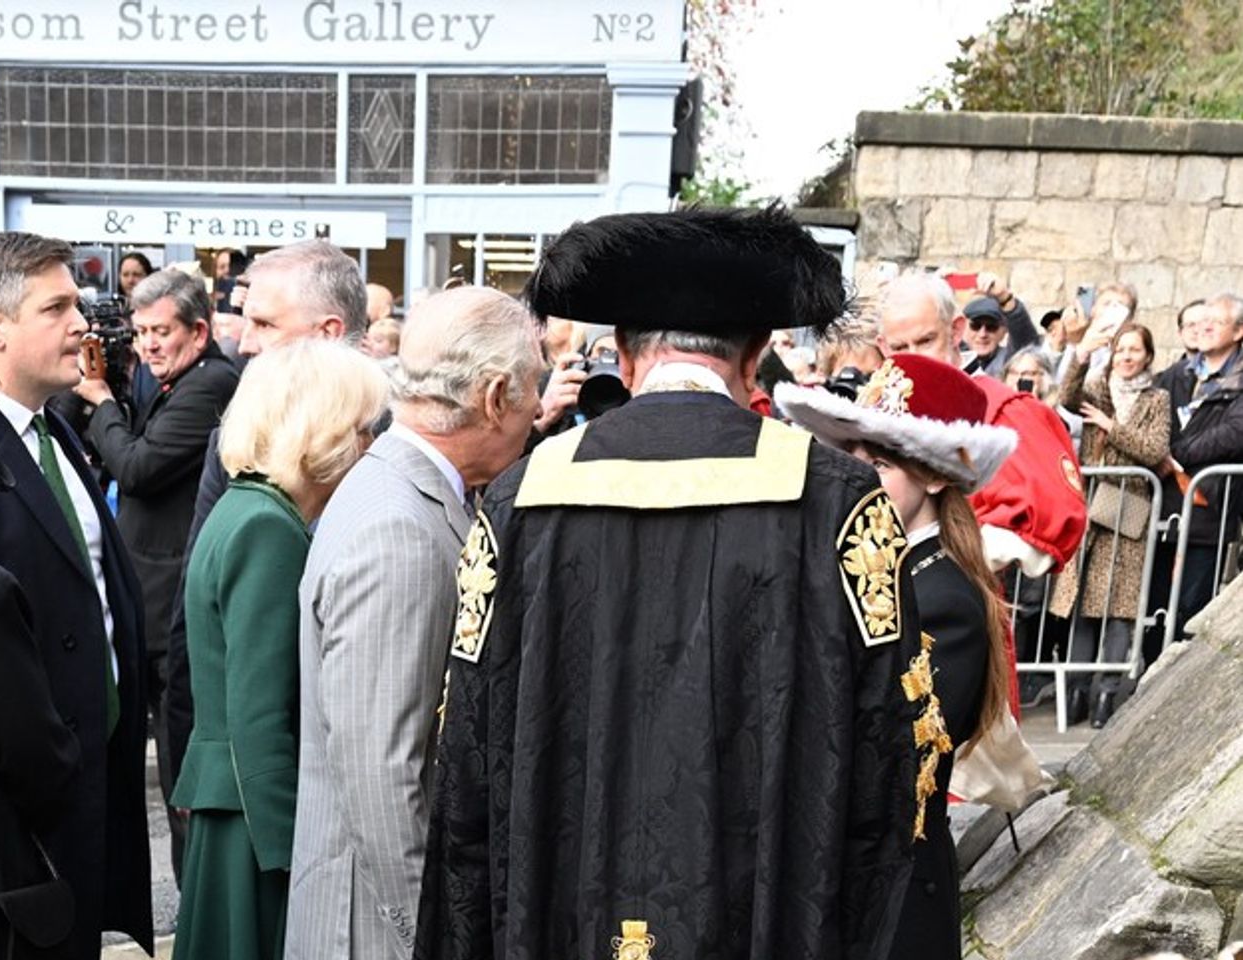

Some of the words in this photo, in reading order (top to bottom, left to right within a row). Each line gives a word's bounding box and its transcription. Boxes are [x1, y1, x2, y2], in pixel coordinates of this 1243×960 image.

[118, 0, 268, 42] Street
[303, 0, 495, 50] Gallery
[105, 210, 134, 234] &
[164, 211, 307, 238] Frames
